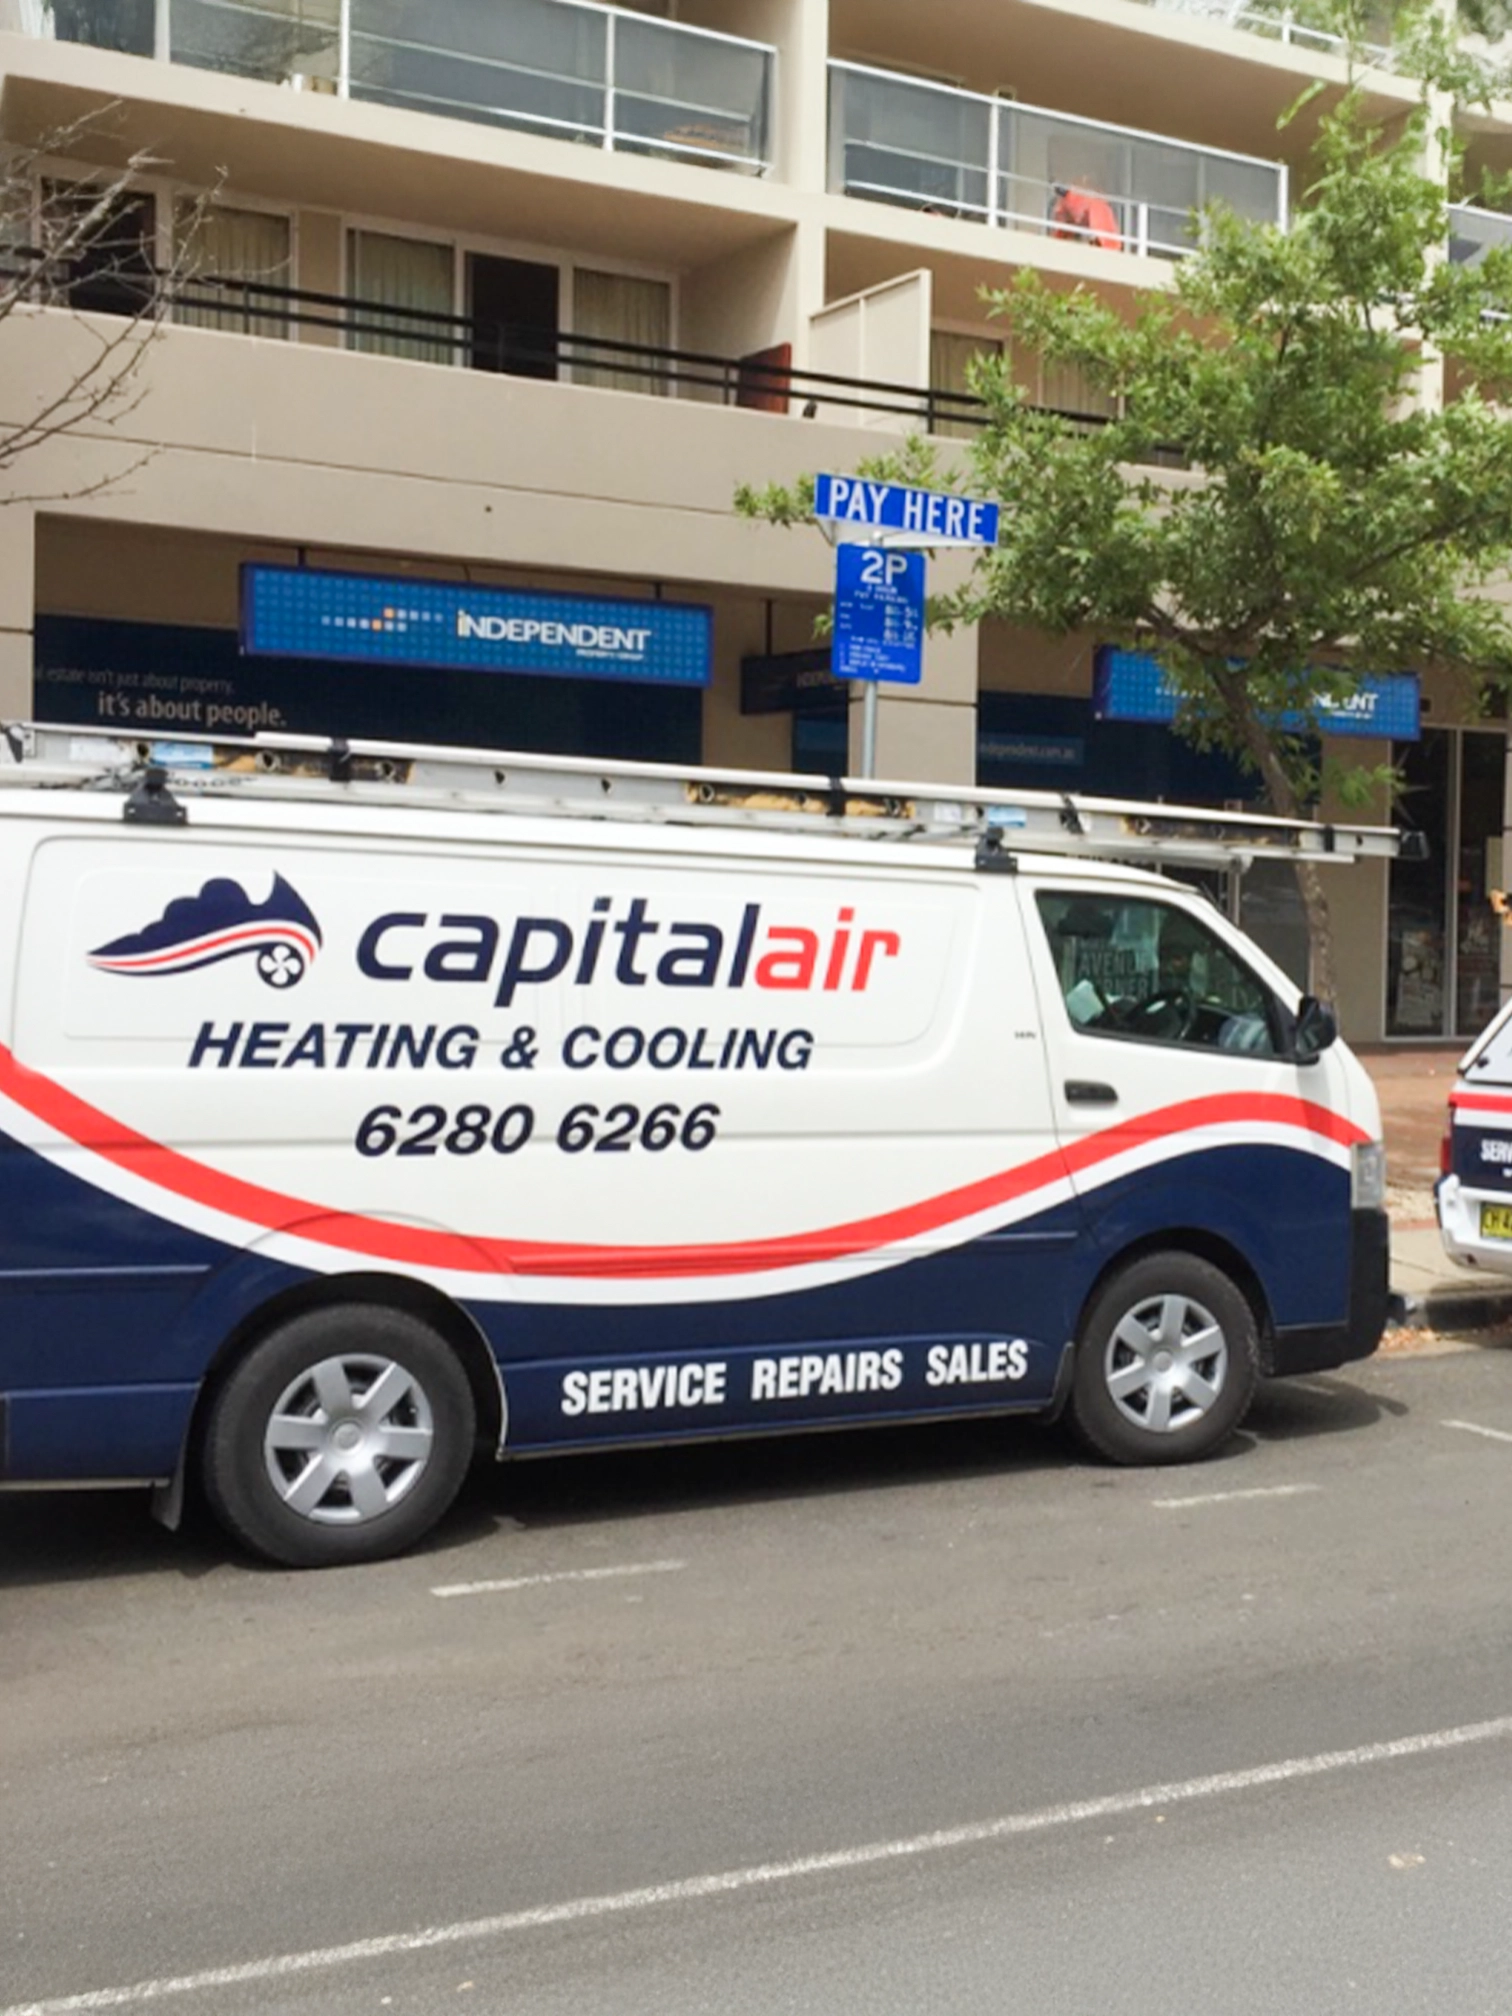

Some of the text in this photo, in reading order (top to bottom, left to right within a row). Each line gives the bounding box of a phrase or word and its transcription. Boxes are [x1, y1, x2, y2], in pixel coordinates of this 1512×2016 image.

[829, 477, 985, 541] PAY HERE
[860, 550, 908, 585] 2P
[98, 689, 288, 731] it's about people.
[188, 1021, 815, 1071] HEATING & COOLING
[353, 1102, 722, 1157] 6280 6266
[560, 1339, 1029, 1416] SERVICE REPAIRS SALES
